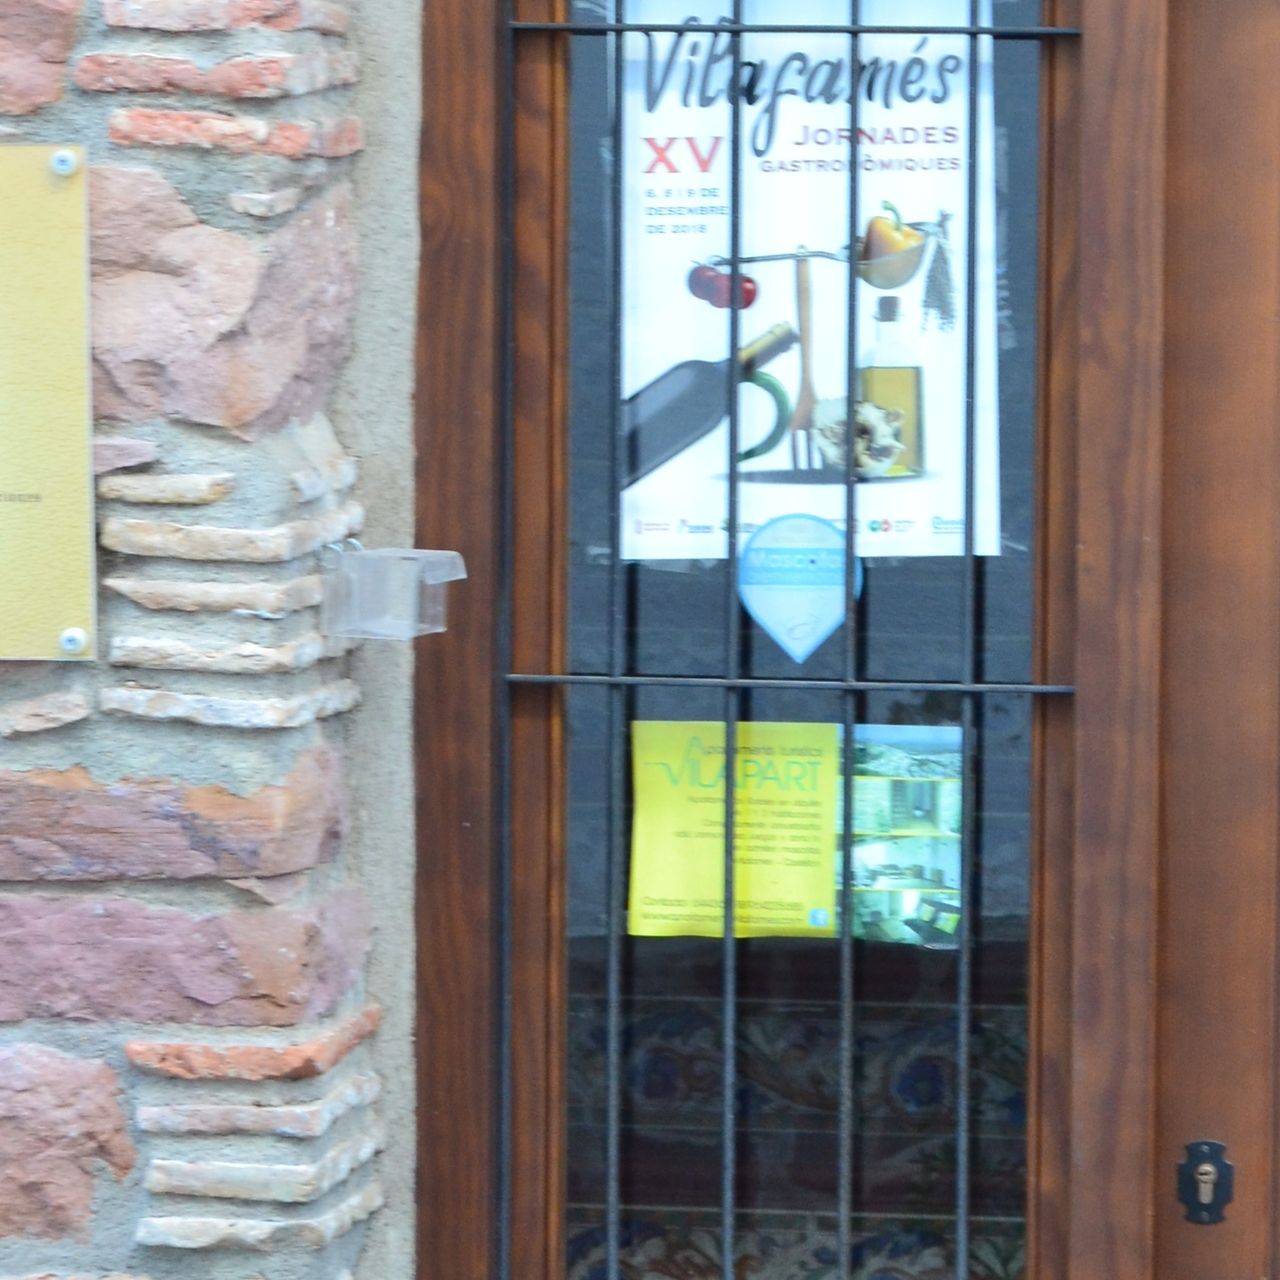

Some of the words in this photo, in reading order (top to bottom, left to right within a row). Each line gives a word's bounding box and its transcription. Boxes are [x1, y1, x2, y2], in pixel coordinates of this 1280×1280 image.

[642, 16, 963, 157] Vilafamés
[794, 124, 960, 147] JORNADES
[642, 136, 724, 174] XV
[760, 154, 962, 173] GASTROÒMIQUES
[645, 205, 729, 216] DESEMBRE
[645, 223, 667, 234] DE
